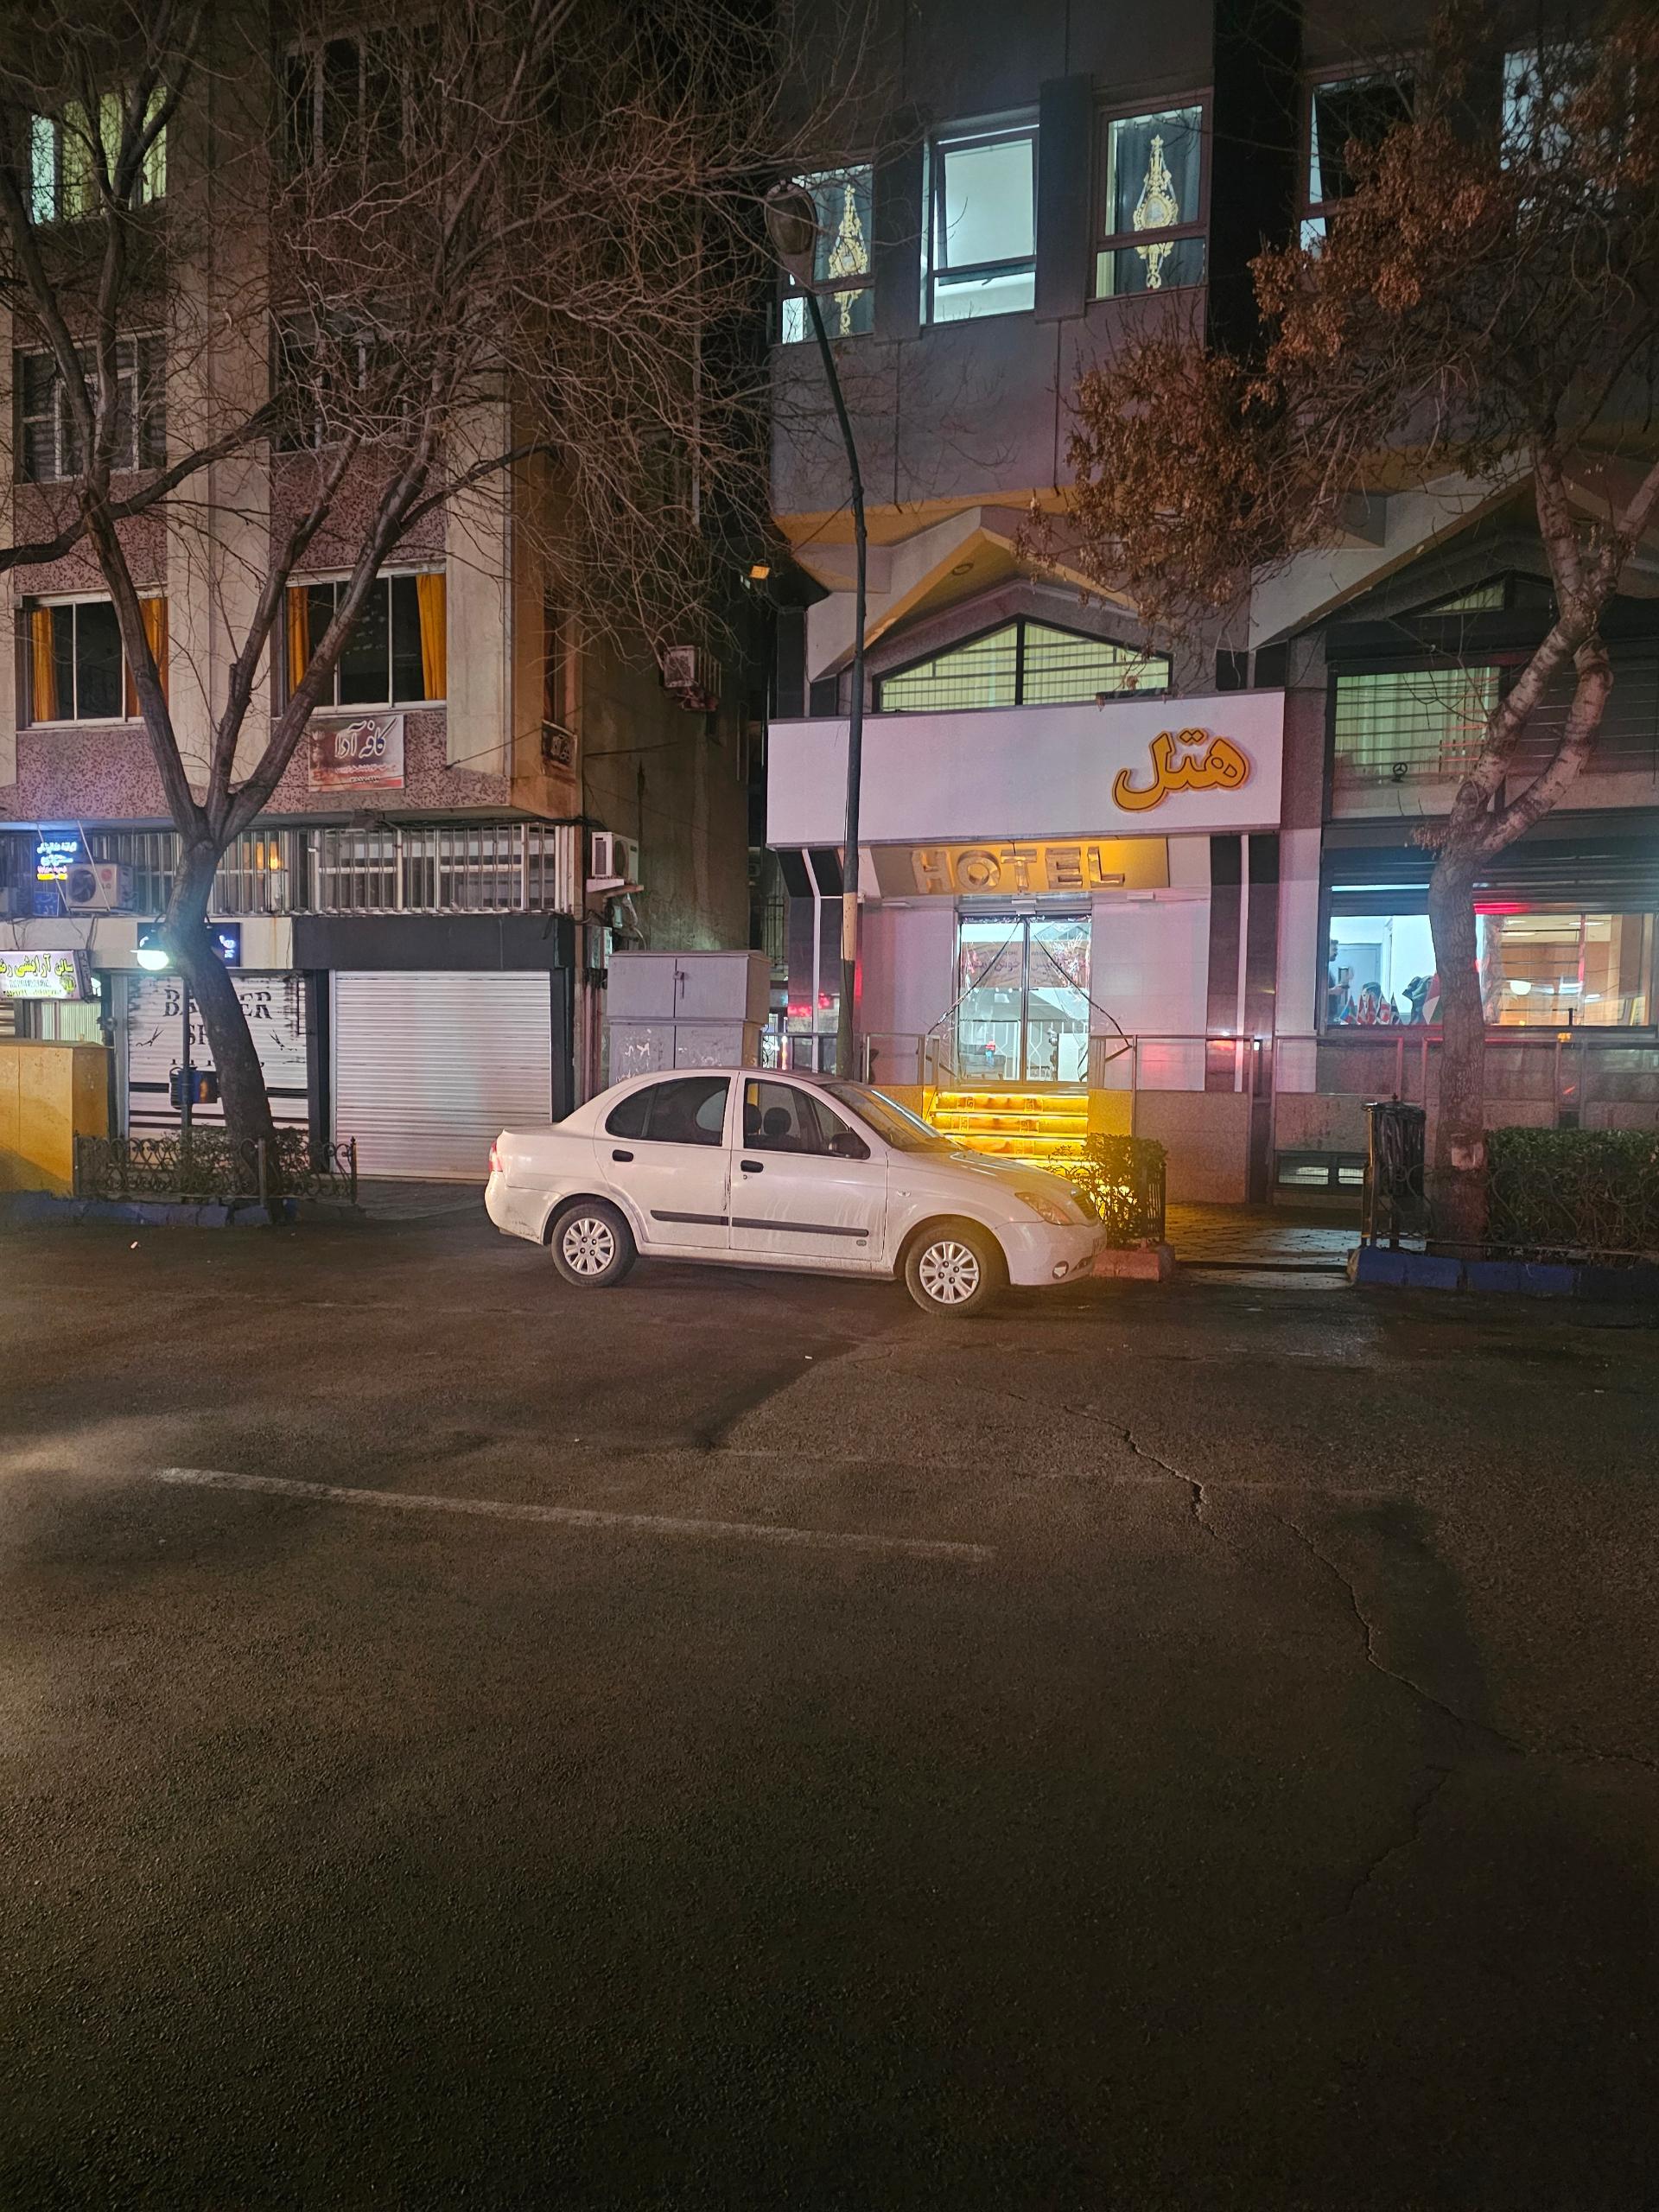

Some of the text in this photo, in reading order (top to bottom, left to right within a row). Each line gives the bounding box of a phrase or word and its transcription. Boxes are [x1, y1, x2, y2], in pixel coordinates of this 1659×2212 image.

[359, 716, 397, 759] کافه
[1112, 728, 1250, 813] هتل
[910, 845, 1126, 893] HOTEL
[54, 957, 74, 976] سالن
[162, 988, 272, 1020] BAER
